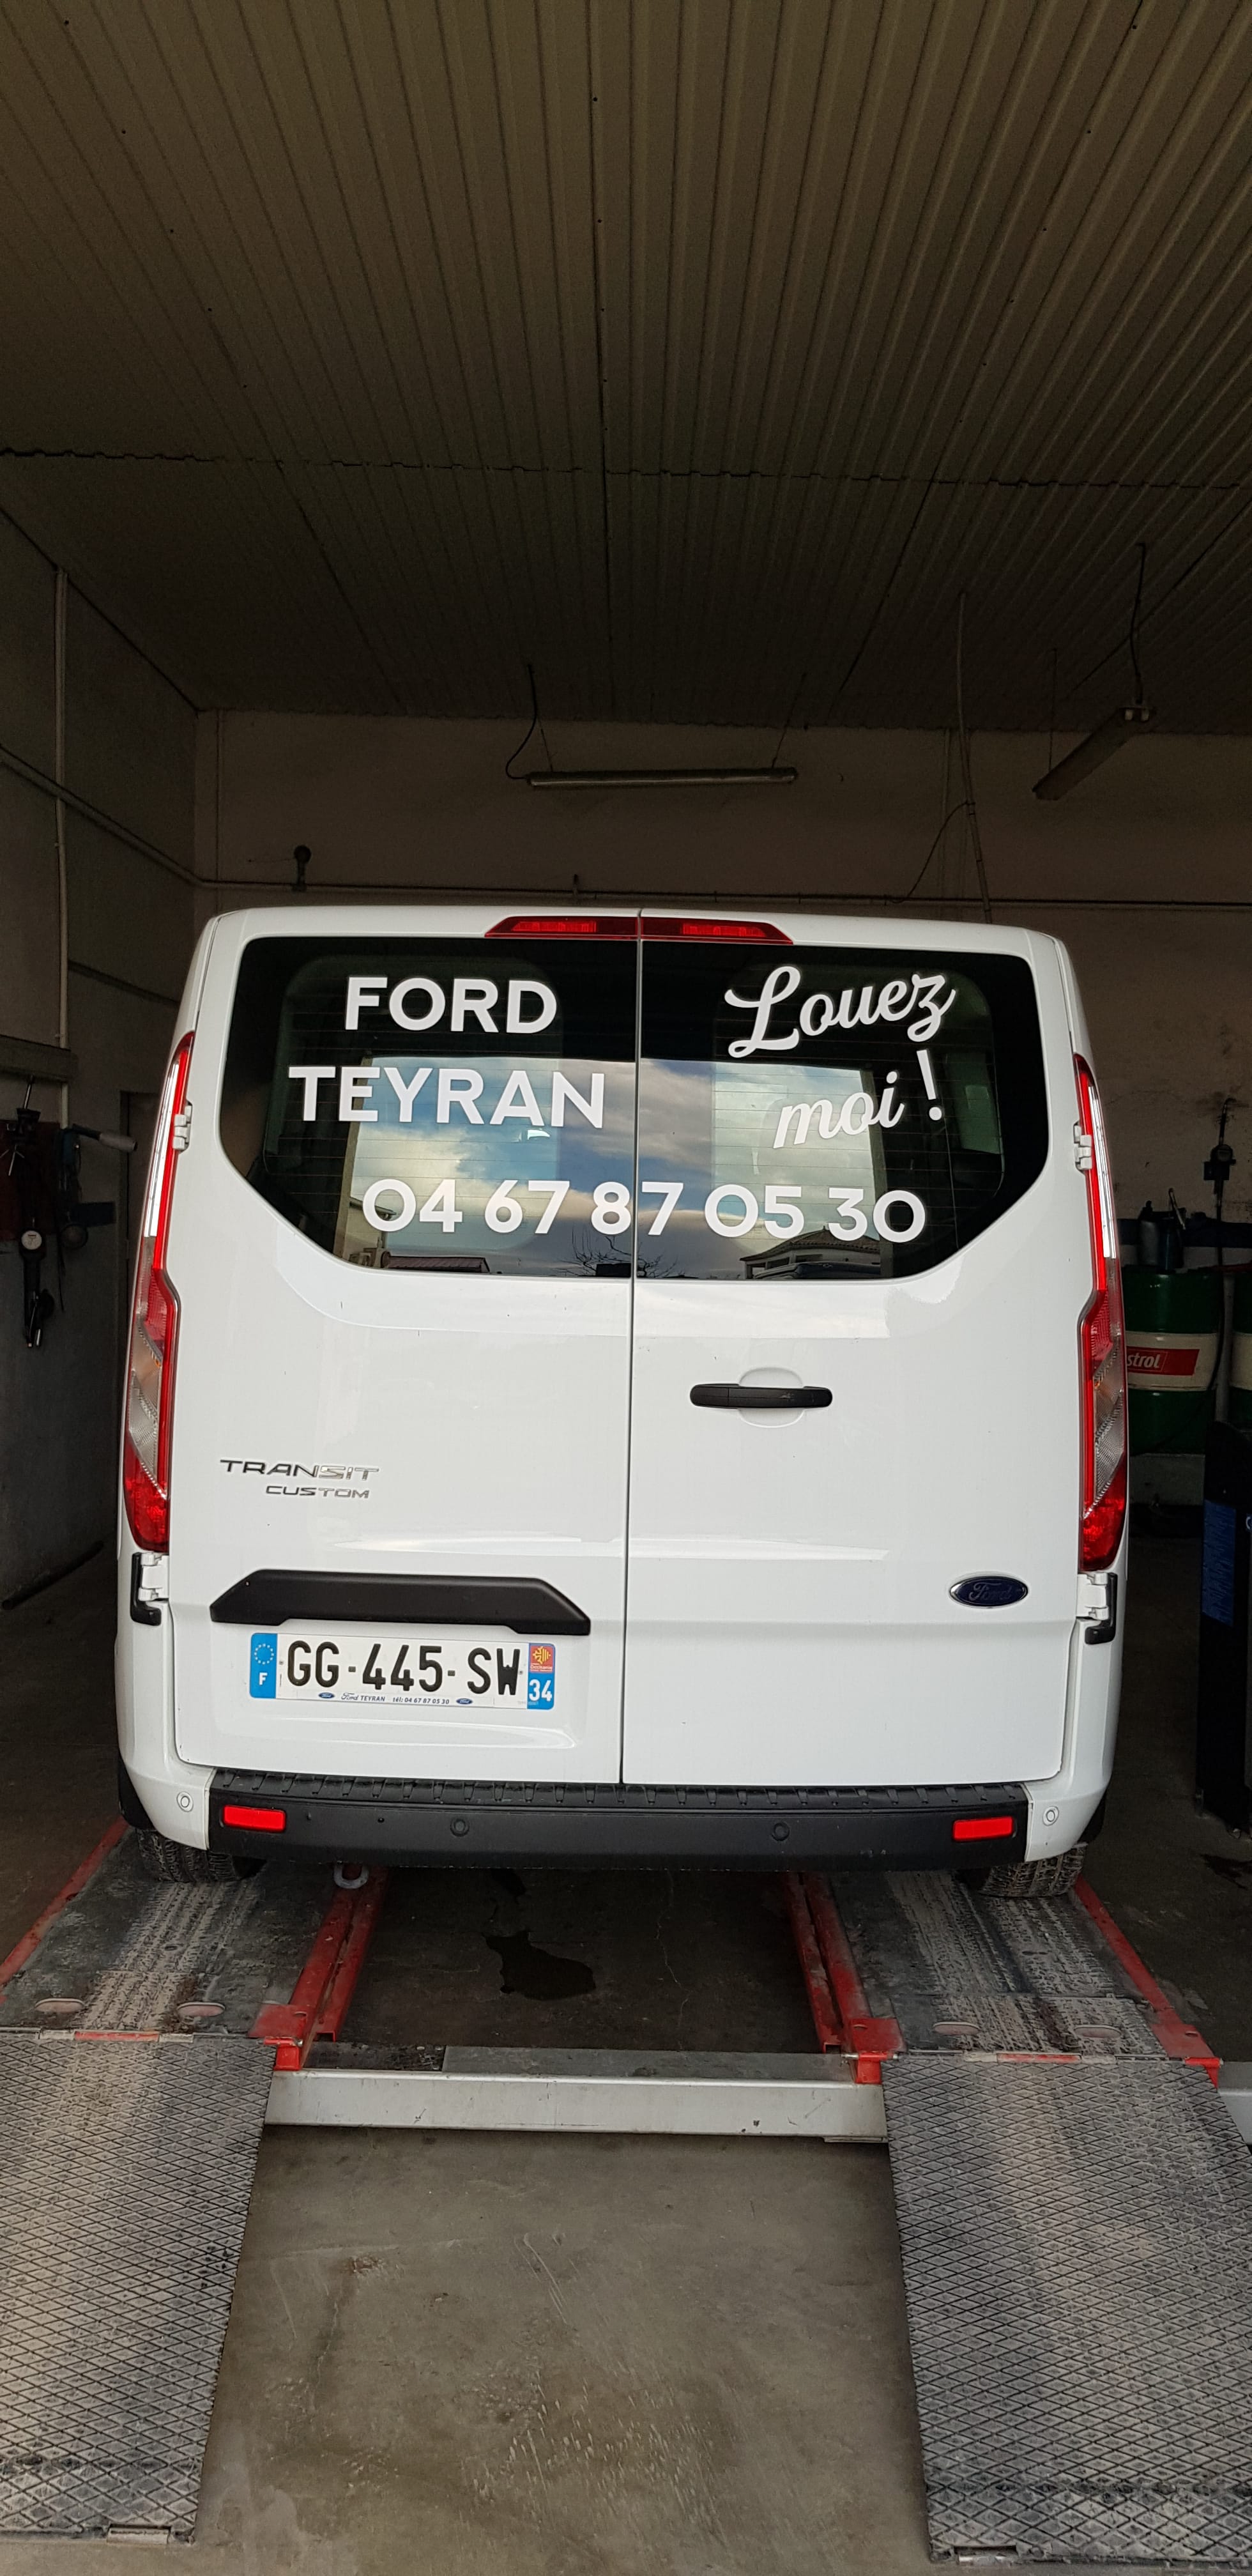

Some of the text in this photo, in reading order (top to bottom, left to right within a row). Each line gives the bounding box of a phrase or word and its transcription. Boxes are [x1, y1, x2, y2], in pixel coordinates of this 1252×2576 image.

[345, 977, 557, 1034] FORD
[724, 965, 956, 1059] Louez
[288, 1066, 605, 1128] TEYRAN
[773, 1050, 942, 1149] moi !
[362, 1179, 926, 1243] 04 67 87 05 30
[1127, 1353, 1161, 1368] strol
[220, 1459, 380, 1481] TRANSIT
[266, 1485, 370, 1499] CUSTOM
[968, 1582, 1012, 1601] Ford
[259, 1672, 268, 1686] F
[287, 1640, 521, 1696] GG-445-SW
[529, 1679, 553, 1702] 34
